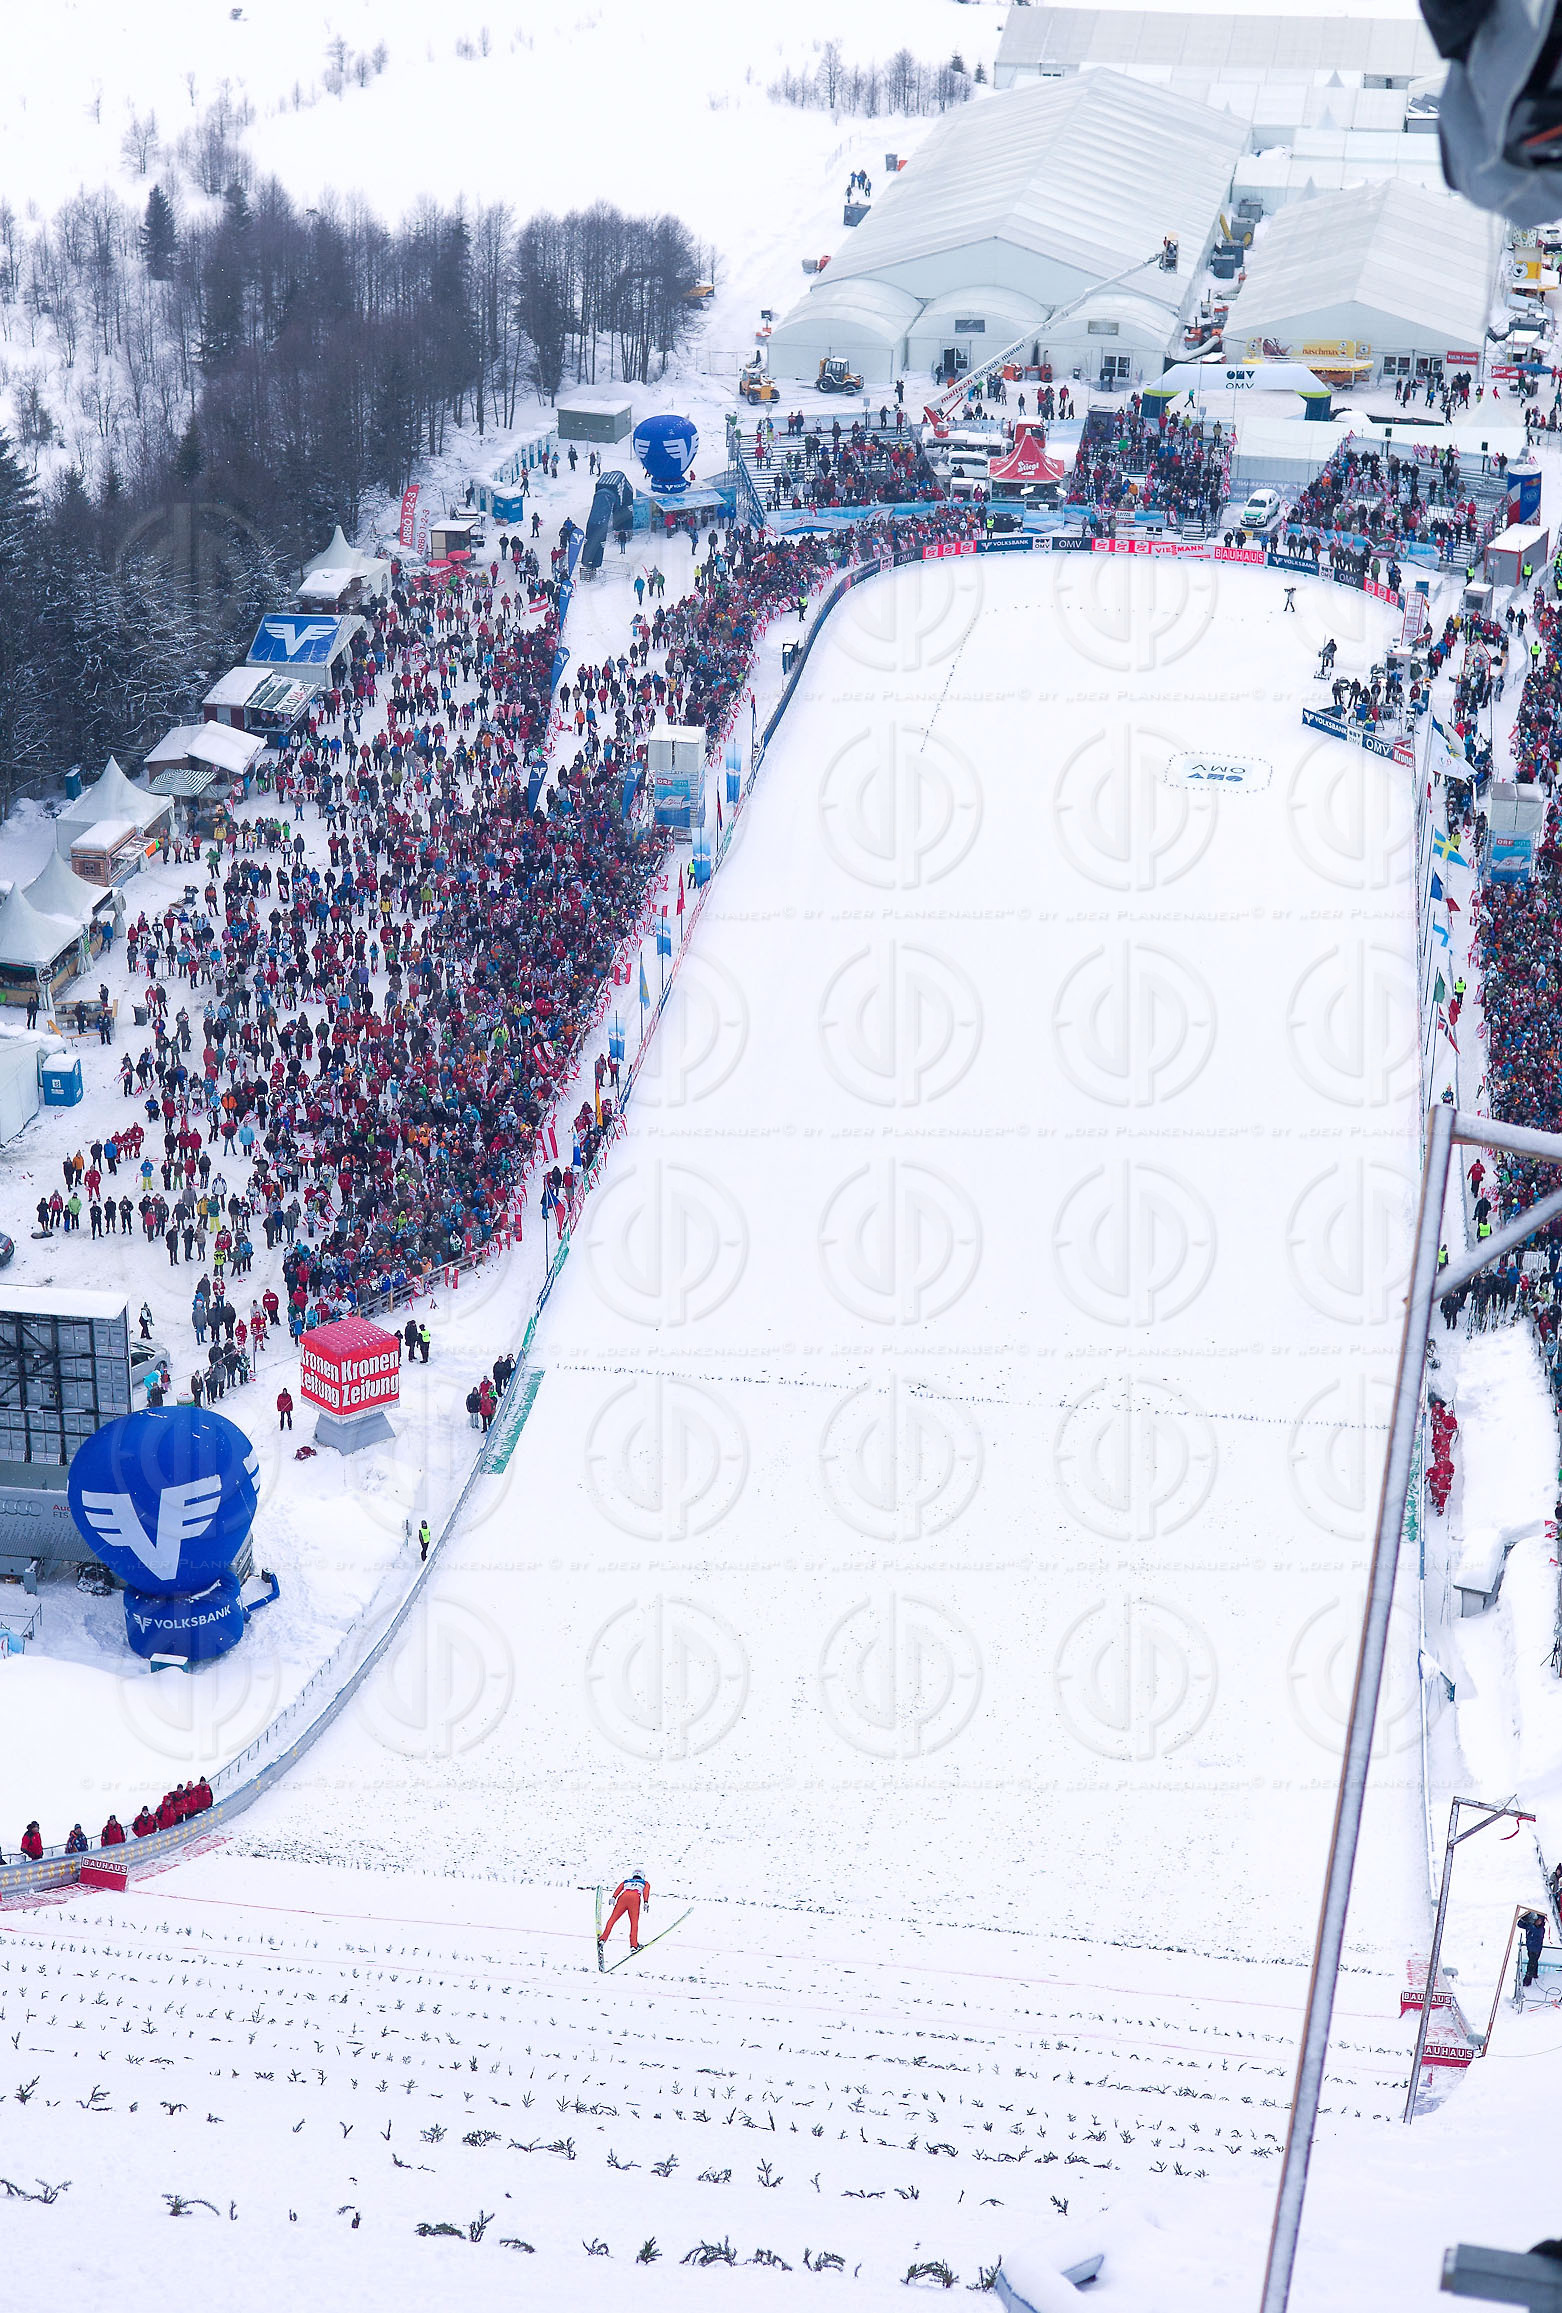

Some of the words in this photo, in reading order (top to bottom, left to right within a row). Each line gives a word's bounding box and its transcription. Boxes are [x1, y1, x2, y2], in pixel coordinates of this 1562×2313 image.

[1001, 343, 1025, 362] mieten
[1225, 382, 1255, 390] OMV
[404, 491, 417, 516] 1-2-3
[401, 518, 413, 544] ARBÖ
[1058, 540, 1082, 548] OMV
[898, 552, 915, 563] OMV
[1215, 547, 1264, 563] BAUHAUS
[1283, 558, 1317, 570] VOLKSBANK
[1339, 573, 1358, 585] OMV
[1315, 717, 1347, 735] VOLKSBANK
[1366, 739, 1389, 756] OMV
[1394, 749, 1413, 765] Krone
[341, 1349, 399, 1383] Kronen
[341, 1373, 399, 1407] Zeitung
[154, 1605, 231, 1630] VOLKSBANK
[83, 1858, 128, 1874] BAUHAUS
[1403, 1993, 1451, 2005] BAUAUS
[1425, 2045, 1474, 2059] AUHAUS
